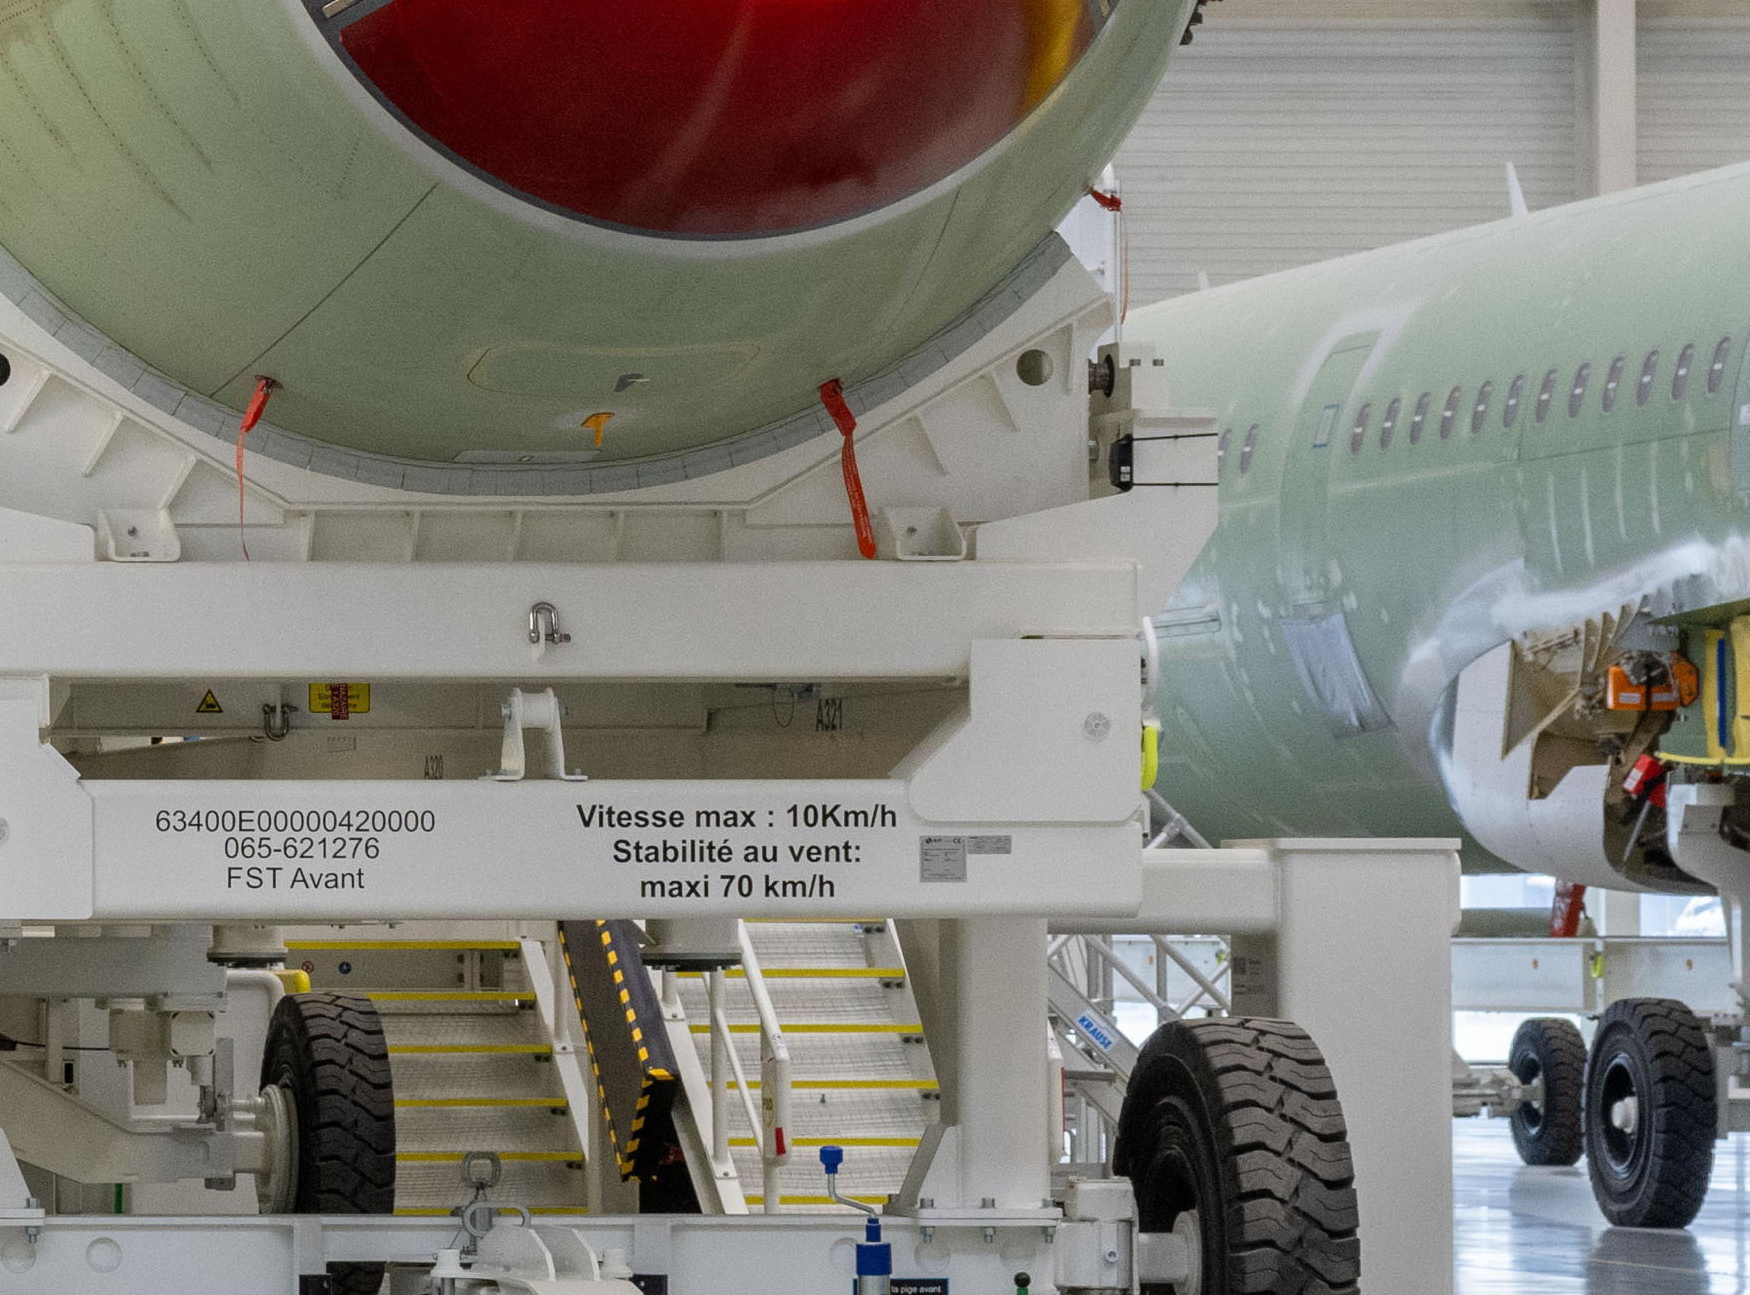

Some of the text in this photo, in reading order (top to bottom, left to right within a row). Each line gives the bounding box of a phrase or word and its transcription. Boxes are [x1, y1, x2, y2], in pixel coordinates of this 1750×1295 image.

[155, 809, 436, 832] 63400E00000420000
[576, 804, 897, 828] Vitesse max : 10Km/h
[224, 836, 380, 859] 065-621276
[612, 838, 861, 863] Stabilité au vent:
[227, 866, 365, 889] FST Avant
[640, 874, 835, 898] maxi 70 km/h
[1078, 1016, 1112, 1049] KRAUSE
[900, 1286, 918, 1295] pige
